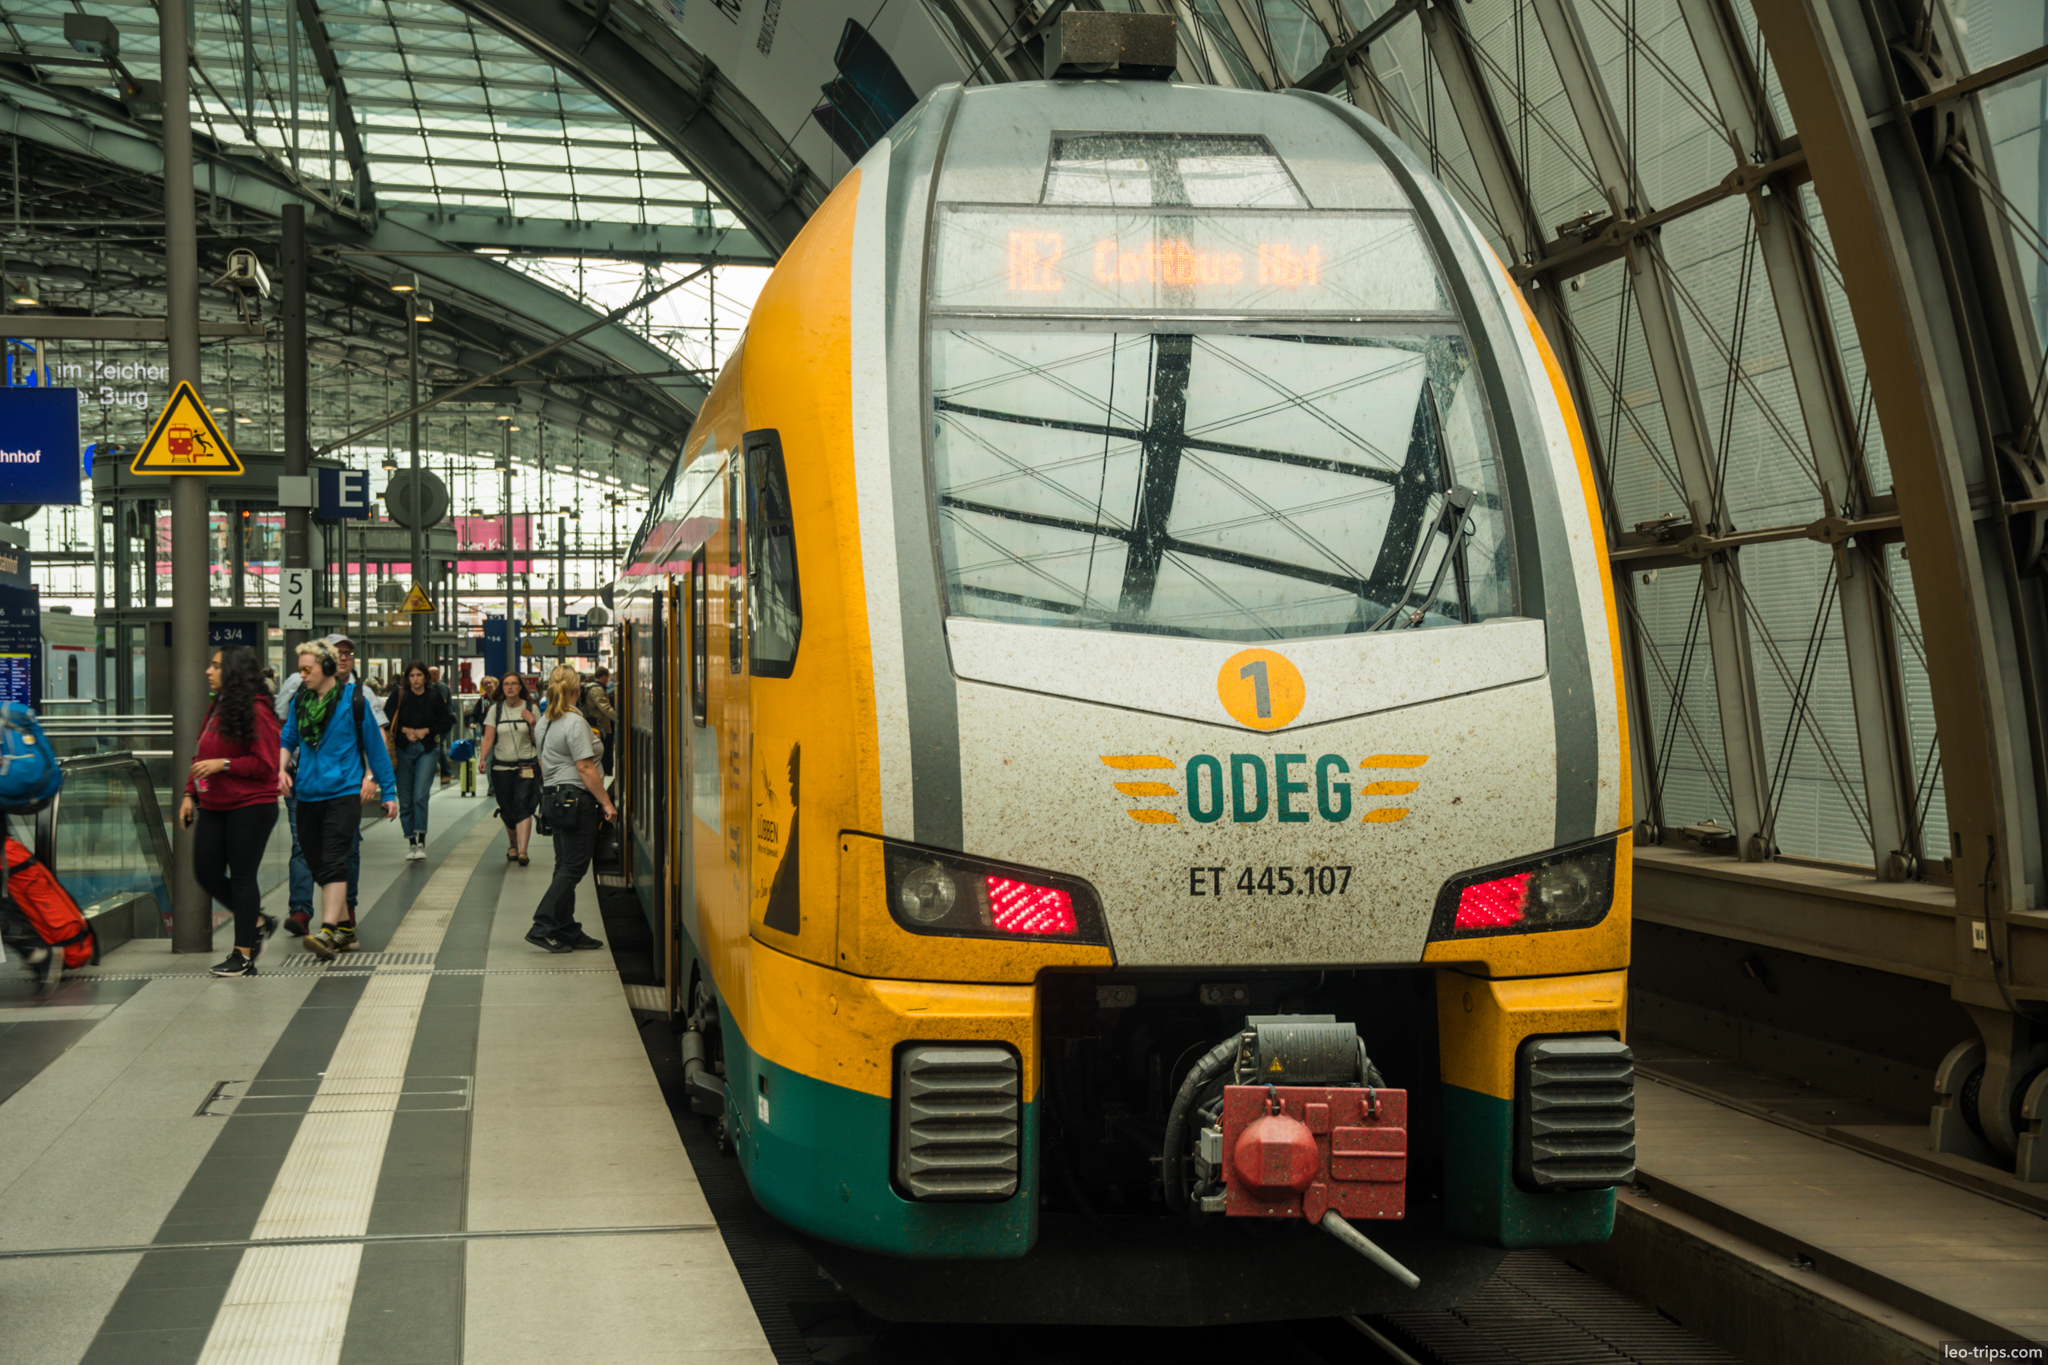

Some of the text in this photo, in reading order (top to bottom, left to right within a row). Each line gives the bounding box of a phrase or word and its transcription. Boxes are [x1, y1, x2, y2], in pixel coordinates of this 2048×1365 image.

[1008, 232, 1322, 290] RE2 Cottbus Hbf
[57, 360, 82, 379] im
[100, 386, 148, 410] Burg
[0, 449, 41, 463] hnhof
[339, 471, 364, 507] E
[288, 573, 303, 595] 5
[288, 598, 304, 620] 4
[576, 614, 585, 628] F
[224, 628, 243, 640] 3/4
[585, 639, 596, 650] 11
[1239, 660, 1272, 719] 1
[1185, 753, 1352, 824] ODEG
[1189, 866, 1352, 896] ET 445.107
